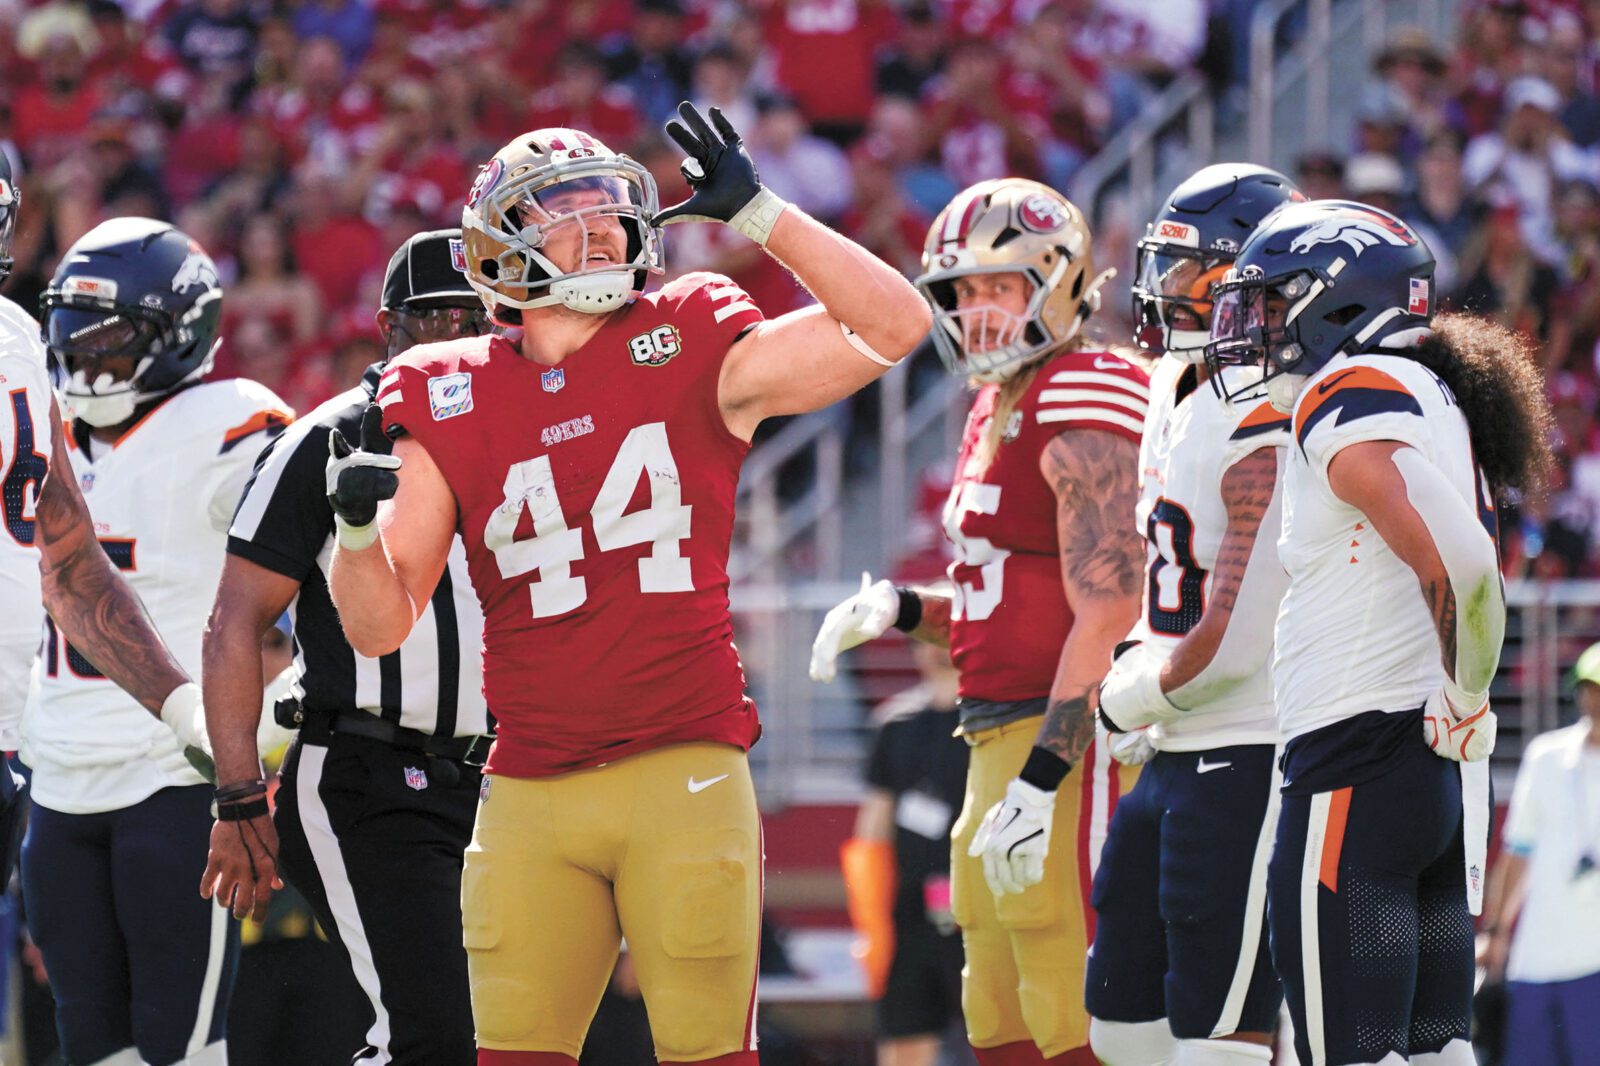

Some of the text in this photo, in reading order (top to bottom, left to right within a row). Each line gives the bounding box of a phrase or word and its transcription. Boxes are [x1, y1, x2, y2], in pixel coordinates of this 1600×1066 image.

[1160, 223, 1189, 240] 5280
[541, 414, 595, 447] 49ERS
[483, 421, 696, 619] 44
